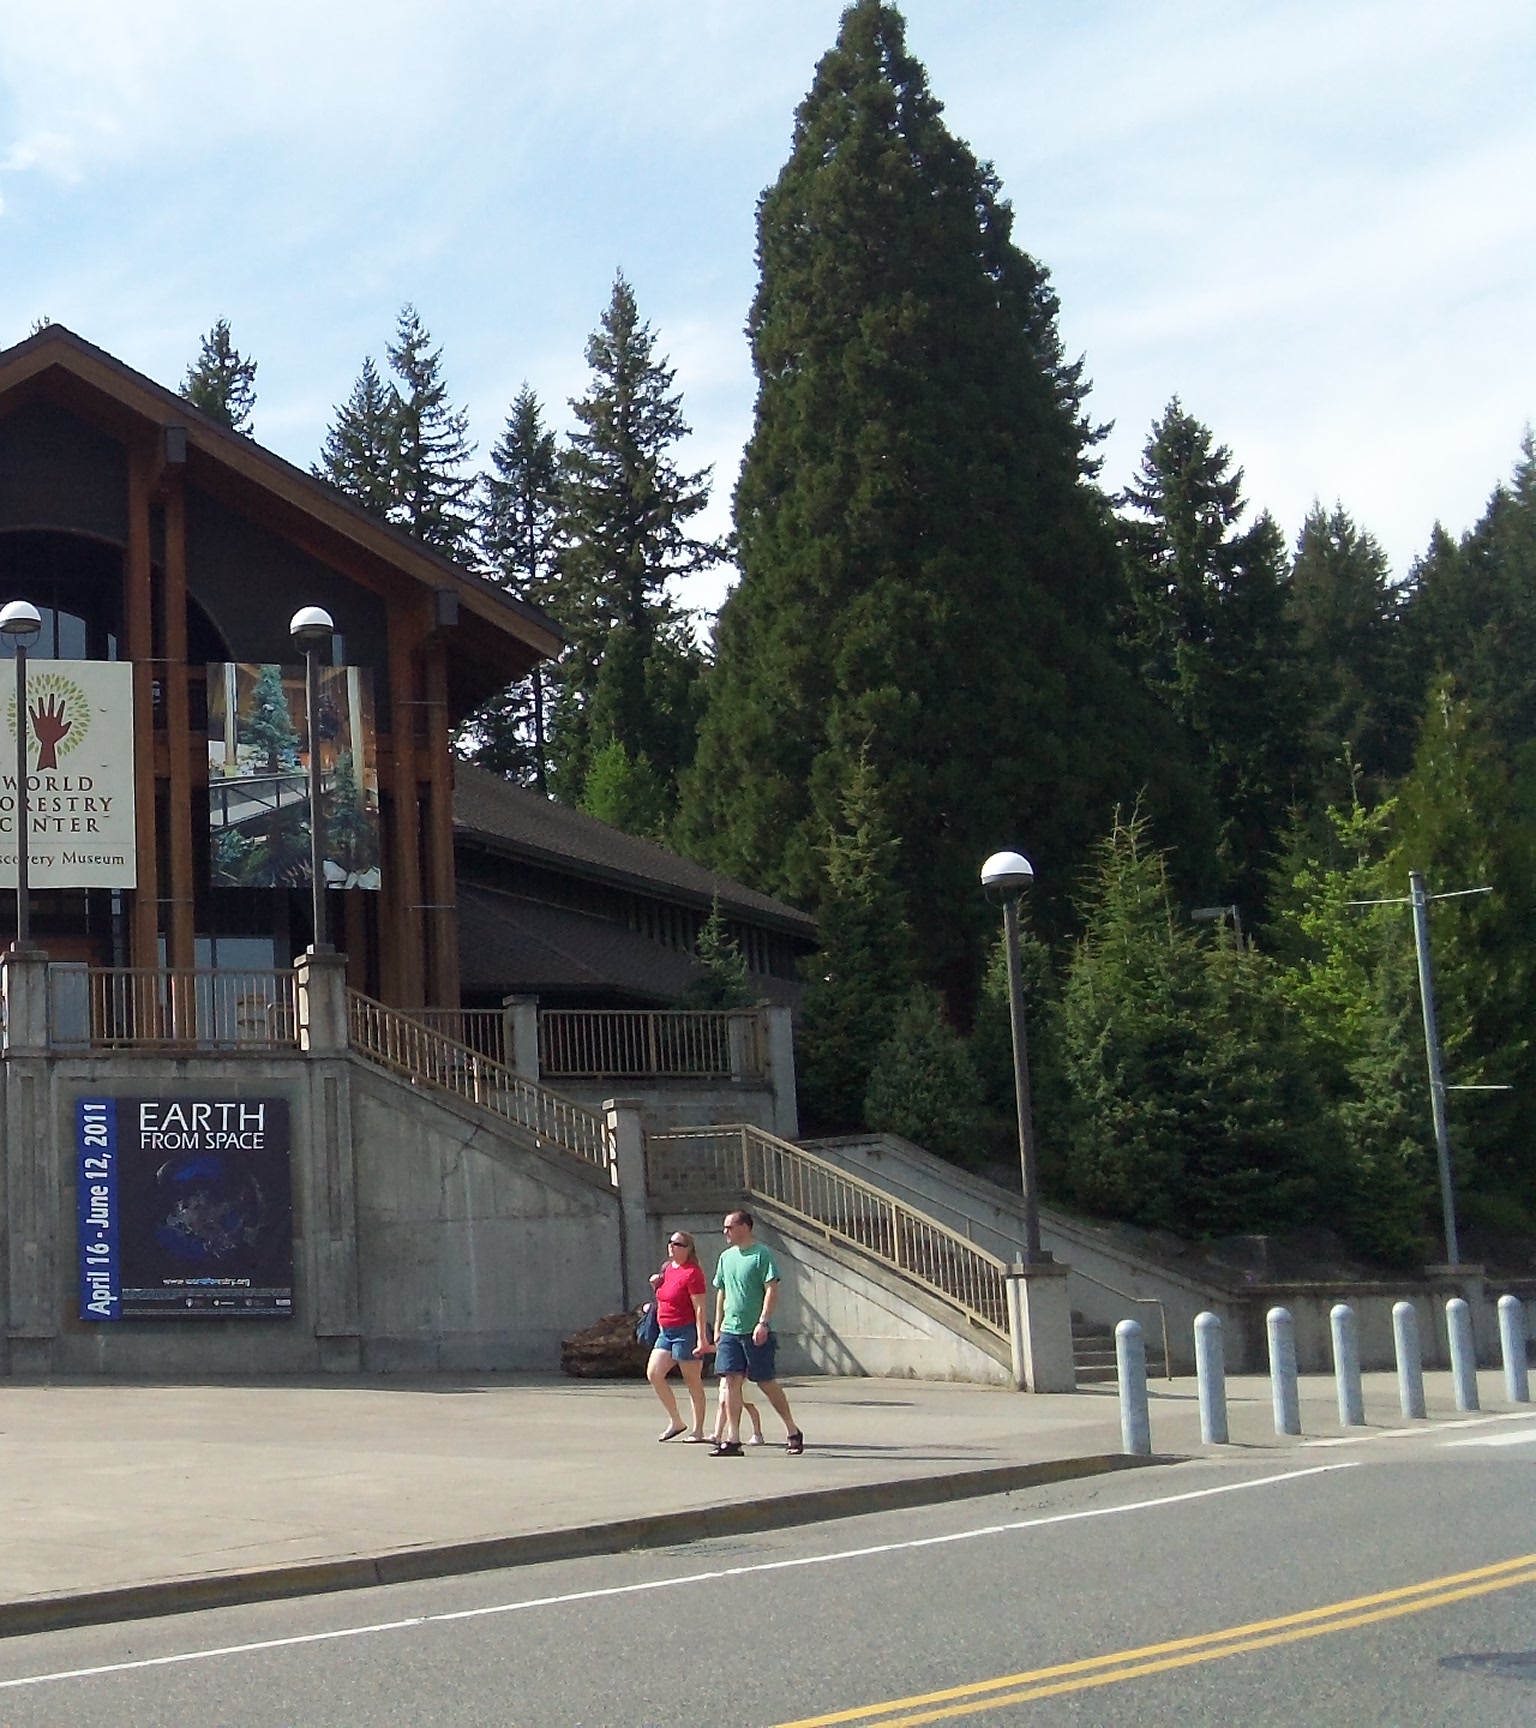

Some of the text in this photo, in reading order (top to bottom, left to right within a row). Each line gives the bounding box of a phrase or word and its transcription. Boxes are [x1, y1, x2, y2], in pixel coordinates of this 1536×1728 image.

[2, 776, 94, 792] WORLD
[62, 851, 125, 865] Museum
[83, 1103, 108, 1147] 2011
[139, 1103, 265, 1131] EARTH
[140, 1132, 265, 1149] FROM SPACE
[84, 1152, 112, 1179] 12,
[85, 1185, 109, 1229] June
[86, 1243, 110, 1264] 16
[86, 1271, 118, 1316] April
